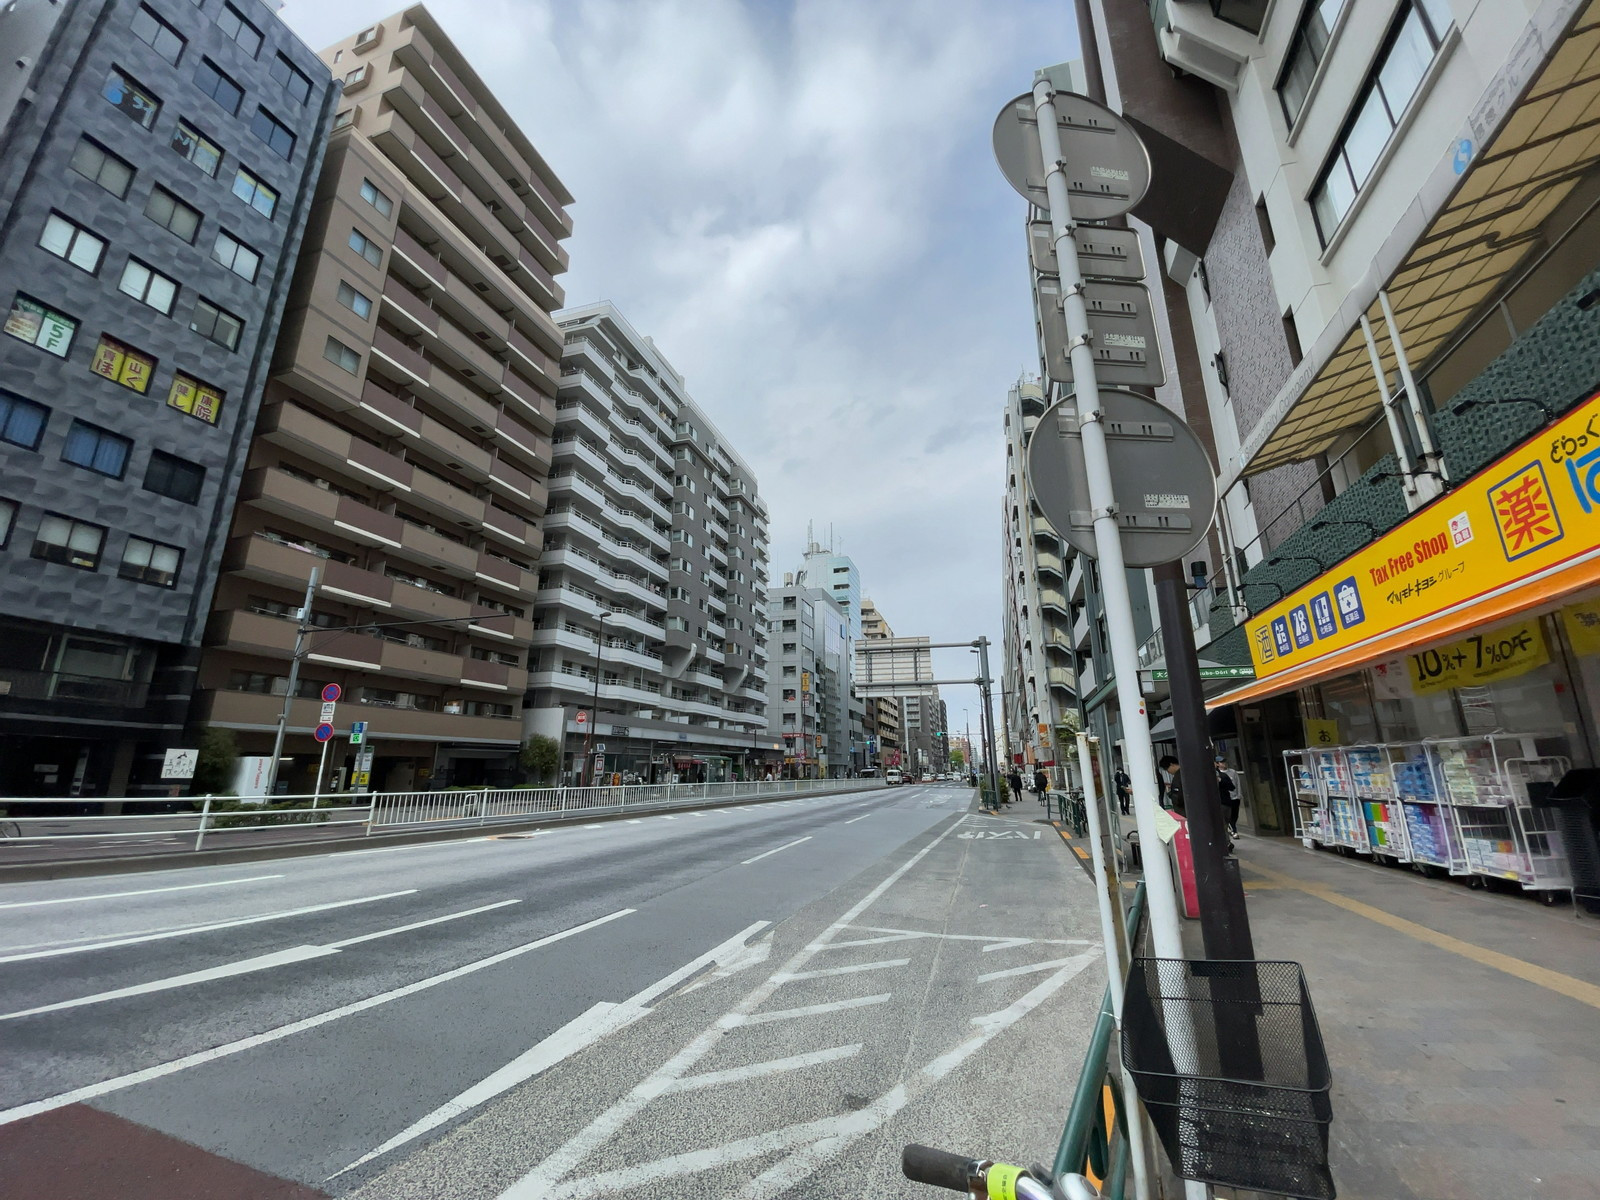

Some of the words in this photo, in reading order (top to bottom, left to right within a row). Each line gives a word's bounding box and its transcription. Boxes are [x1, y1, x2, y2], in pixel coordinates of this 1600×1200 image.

[1550, 413, 1600, 463] どらっぐ
[1495, 474, 1555, 552] 薬
[1369, 564, 1390, 587] Tax
[1387, 551, 1415, 578] Free
[1413, 531, 1449, 564] Shop
